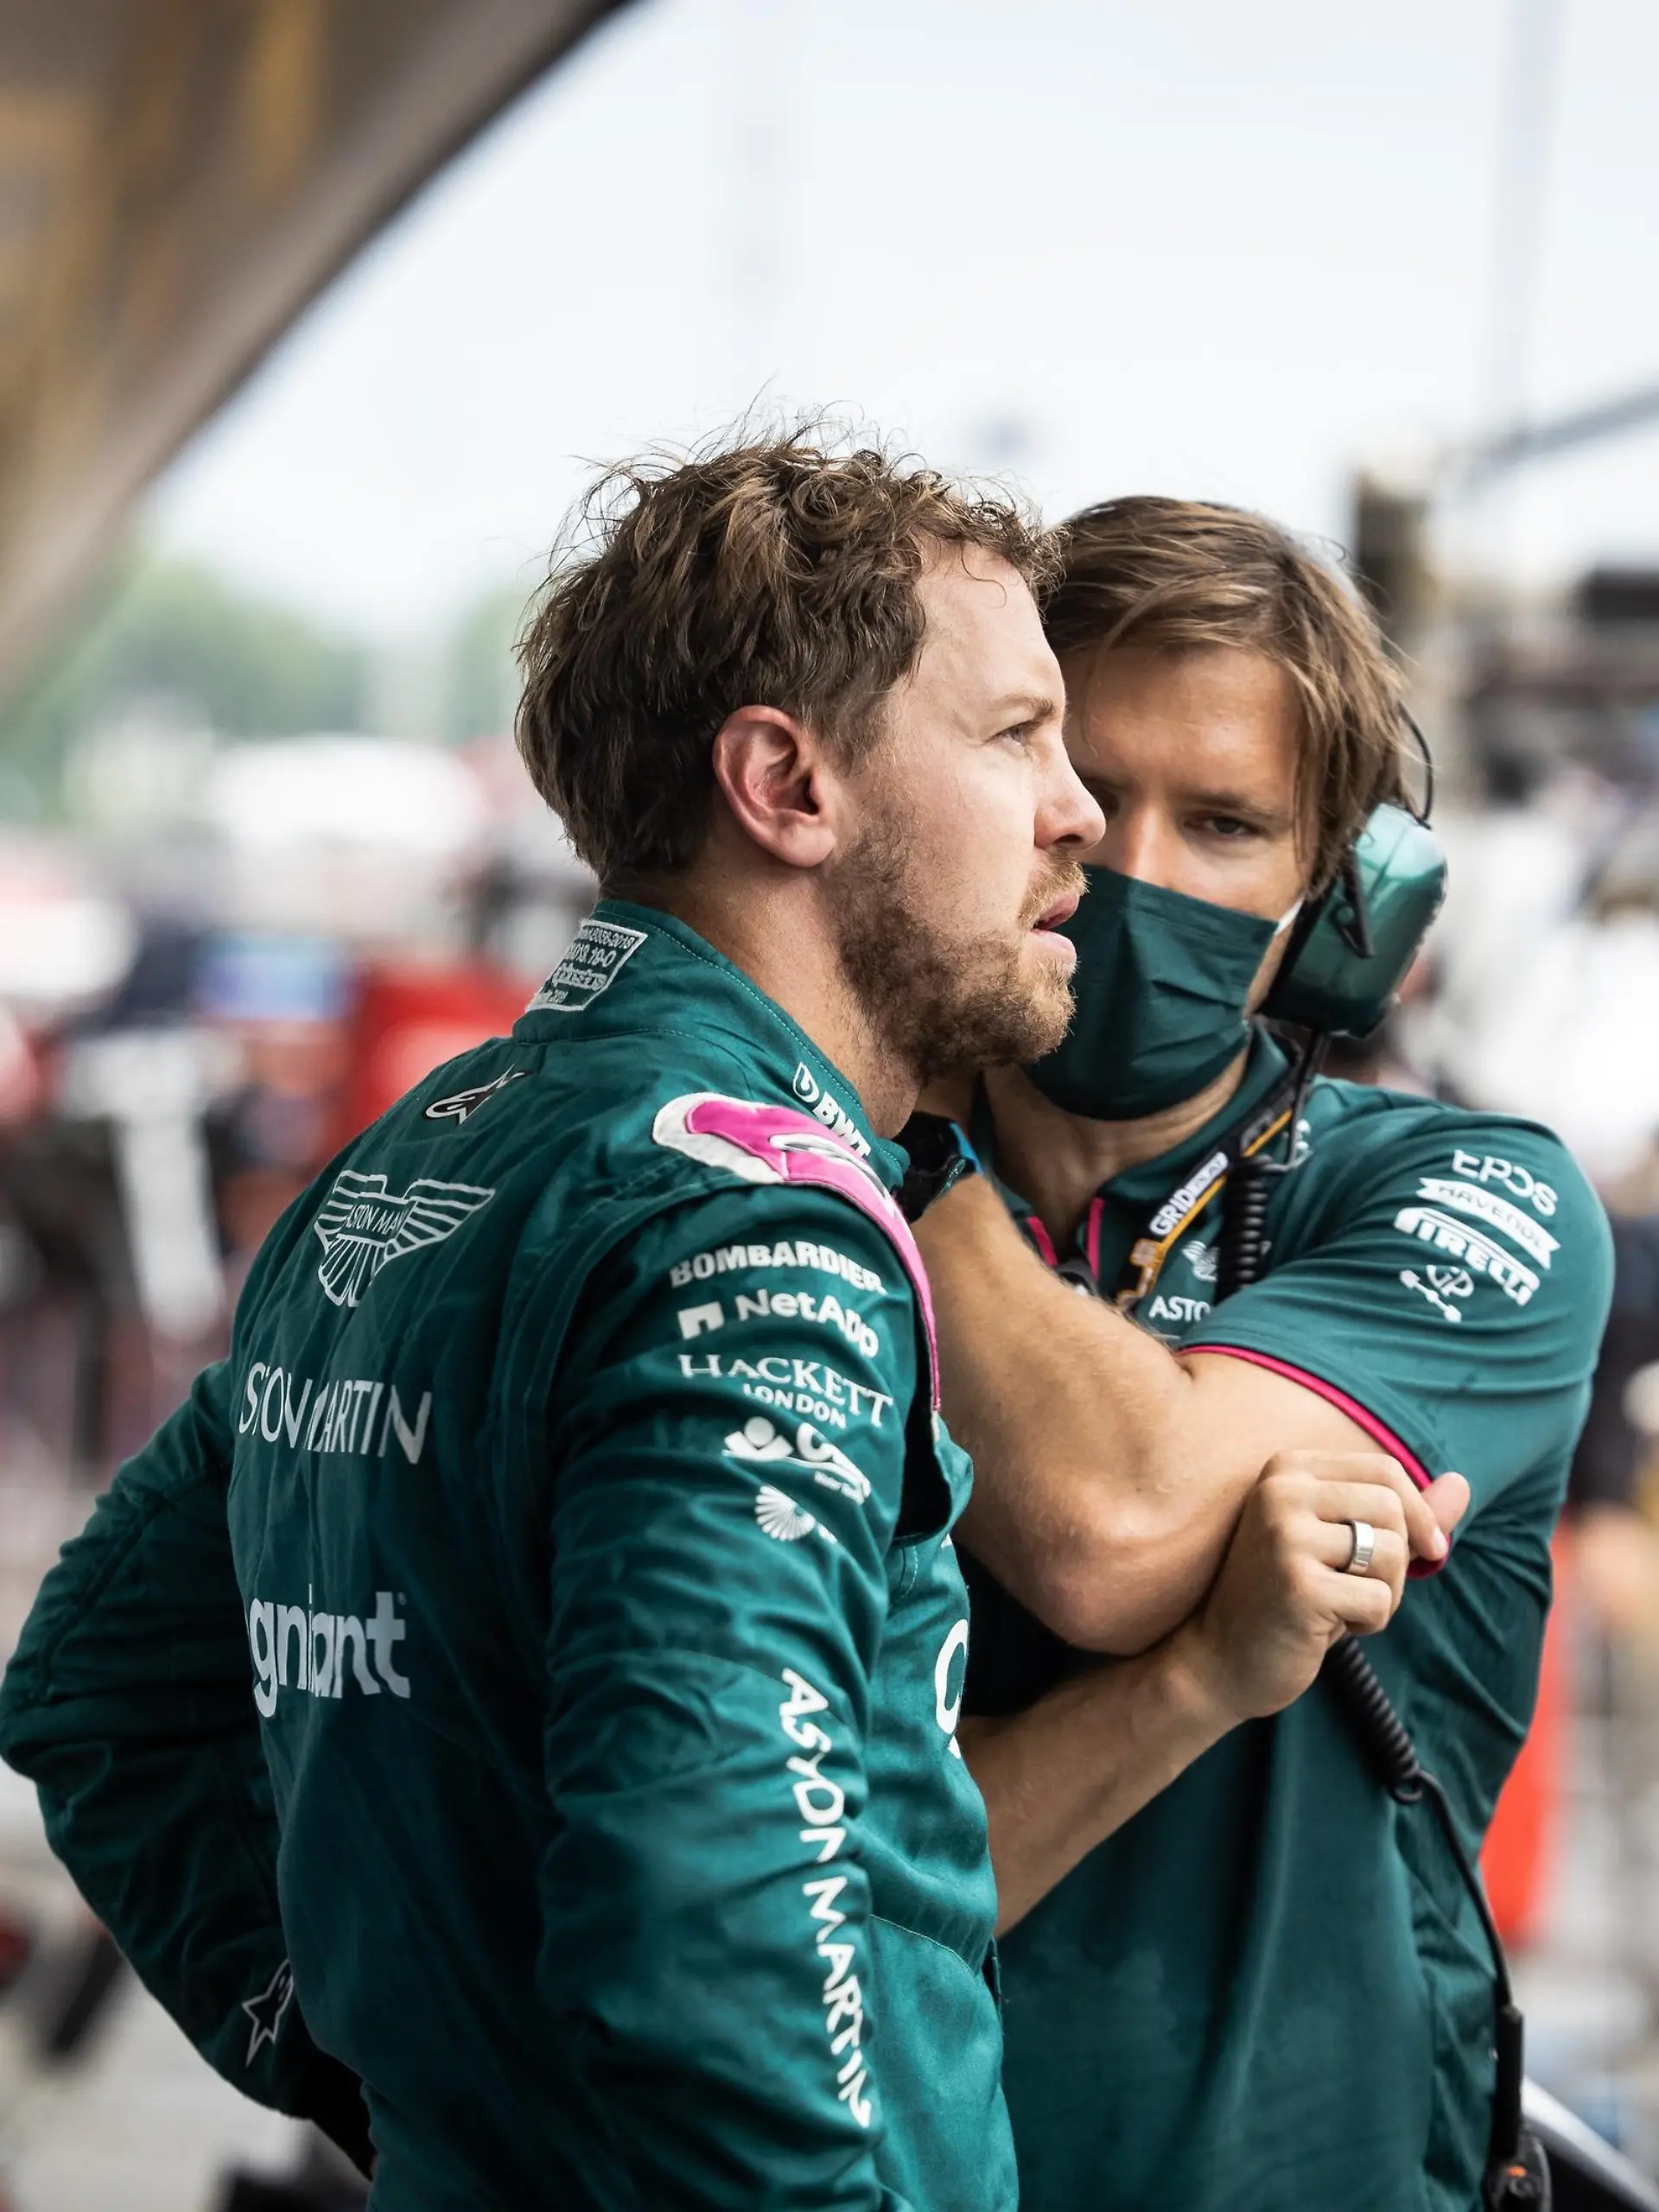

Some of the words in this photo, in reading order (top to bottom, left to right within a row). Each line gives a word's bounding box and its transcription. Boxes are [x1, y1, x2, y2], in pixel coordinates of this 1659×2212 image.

[1452, 1148, 1559, 1217] EPOS
[669, 1241, 887, 1296] BOMBARDIER
[1393, 1207, 1541, 1306] PIRELLI
[677, 1354, 893, 1428] HACKETT
[743, 1383, 847, 1429] LONDON
[802, 1876, 872, 2128] MARTIN
